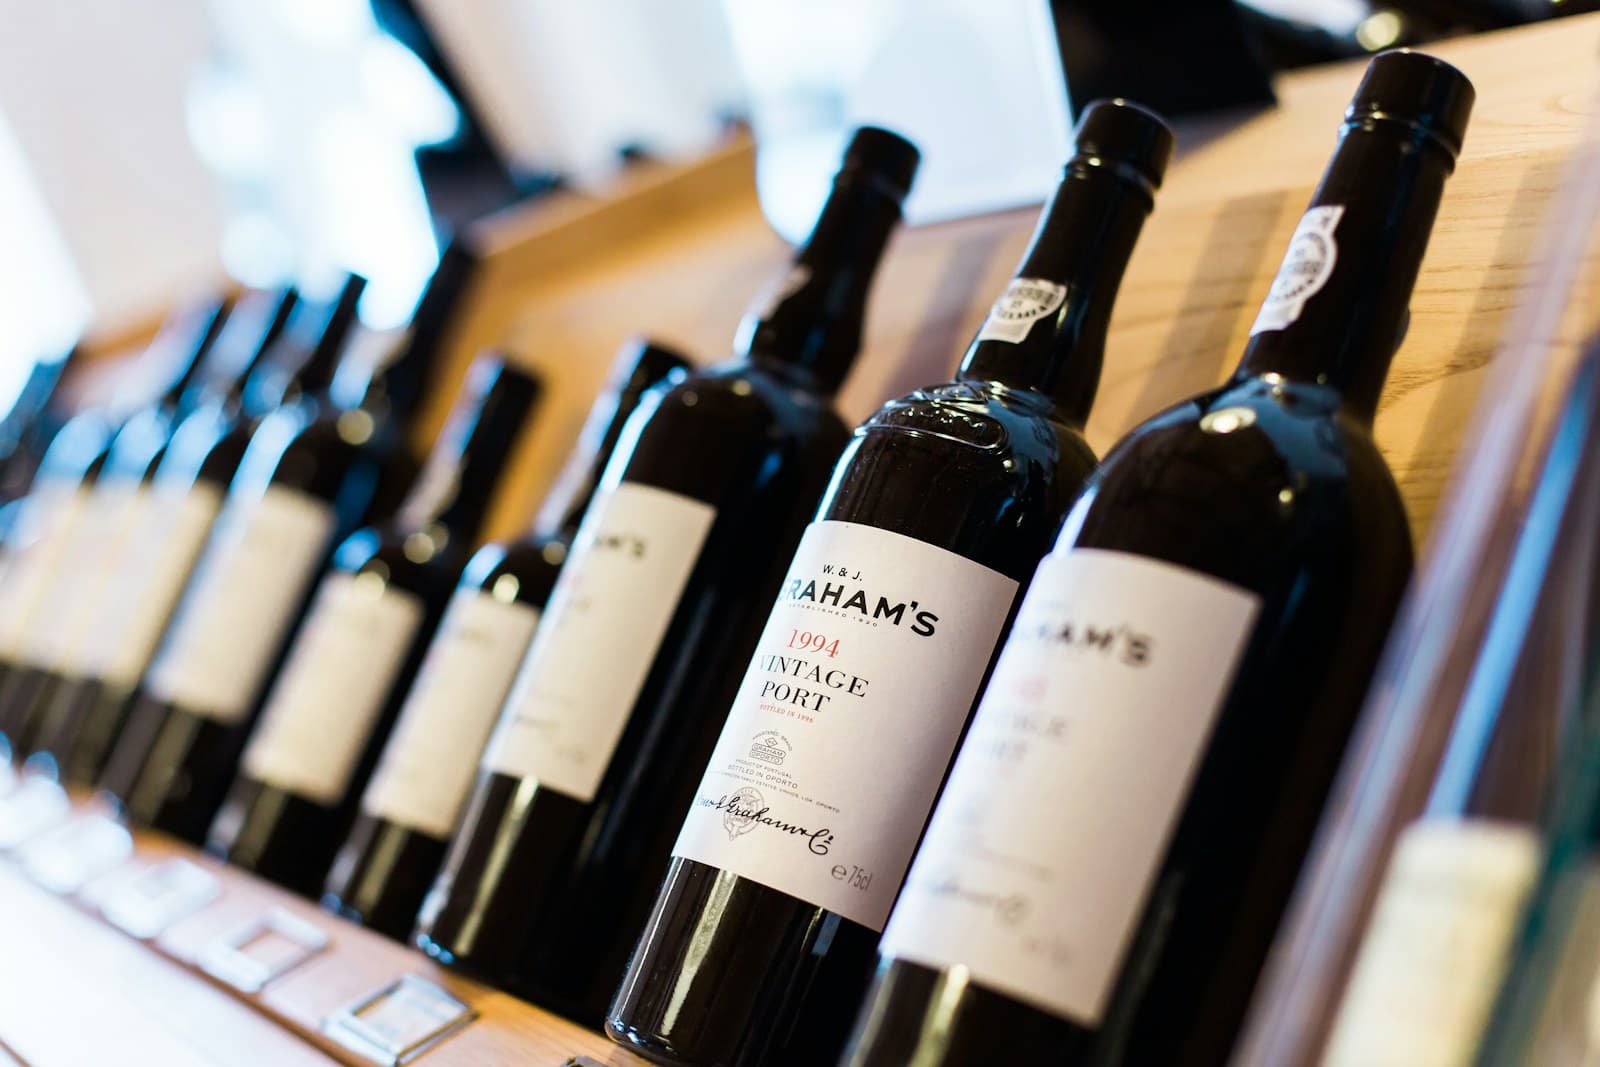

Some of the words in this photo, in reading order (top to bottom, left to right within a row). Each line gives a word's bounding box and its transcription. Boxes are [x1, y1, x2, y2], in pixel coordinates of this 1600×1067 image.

[823, 564, 834, 575] W.
[838, 567, 848, 577] &
[852, 571, 862, 582] J.
[780, 579, 939, 637] RAHAM'S
[786, 629, 841, 659] 1994
[760, 655, 870, 698] VINTAGE
[761, 680, 831, 713] PORT
[751, 752, 781, 764] OPORTO
[753, 744, 784, 757] GRAHAM
[765, 774, 798, 790] OPORTO
[848, 865, 872, 891] 75cl
